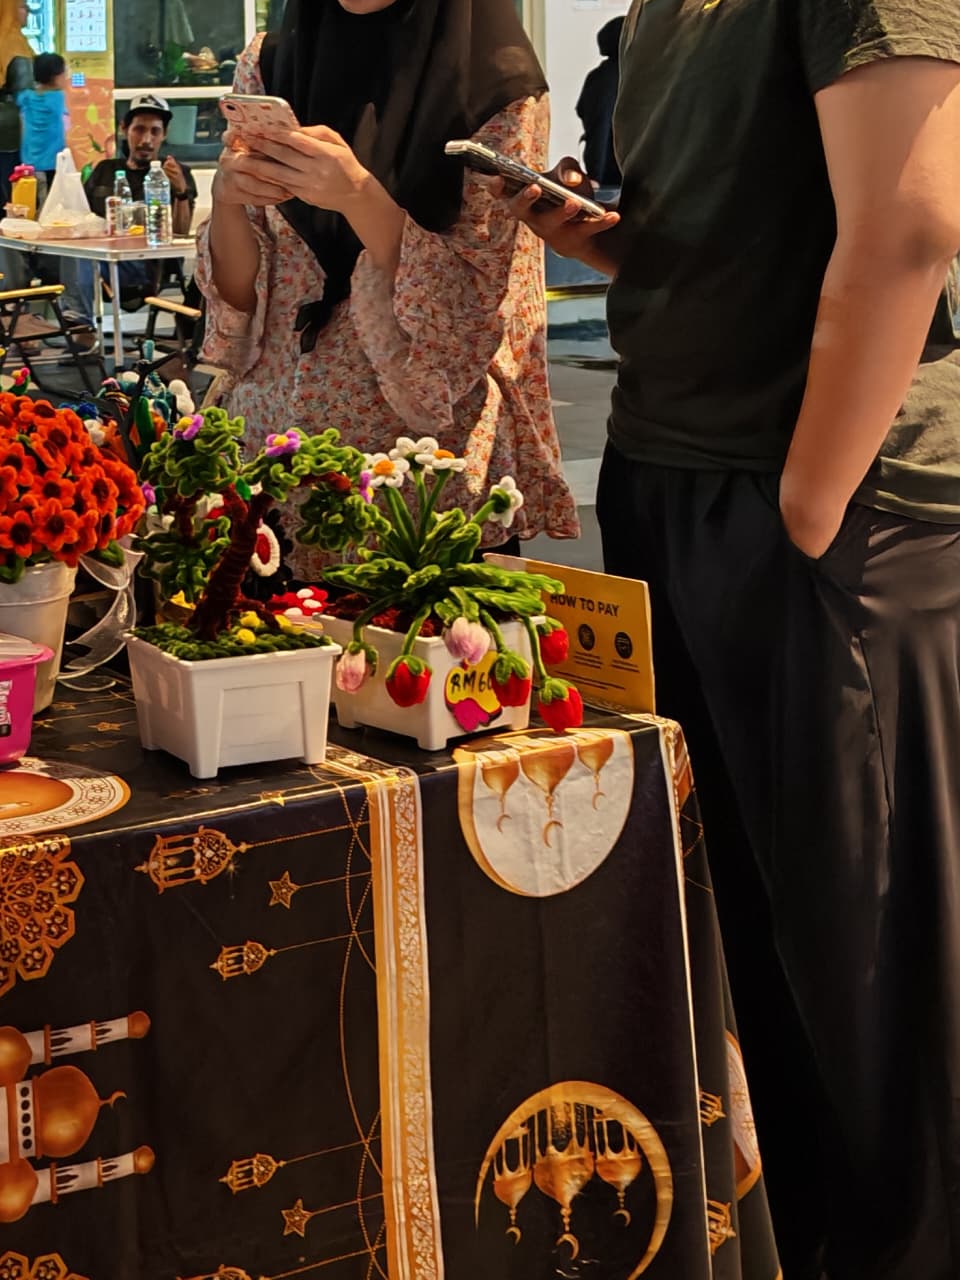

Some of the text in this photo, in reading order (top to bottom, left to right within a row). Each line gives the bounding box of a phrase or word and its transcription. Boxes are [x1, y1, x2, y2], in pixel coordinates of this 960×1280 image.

[550, 594, 620, 617] HOW TO PAY
